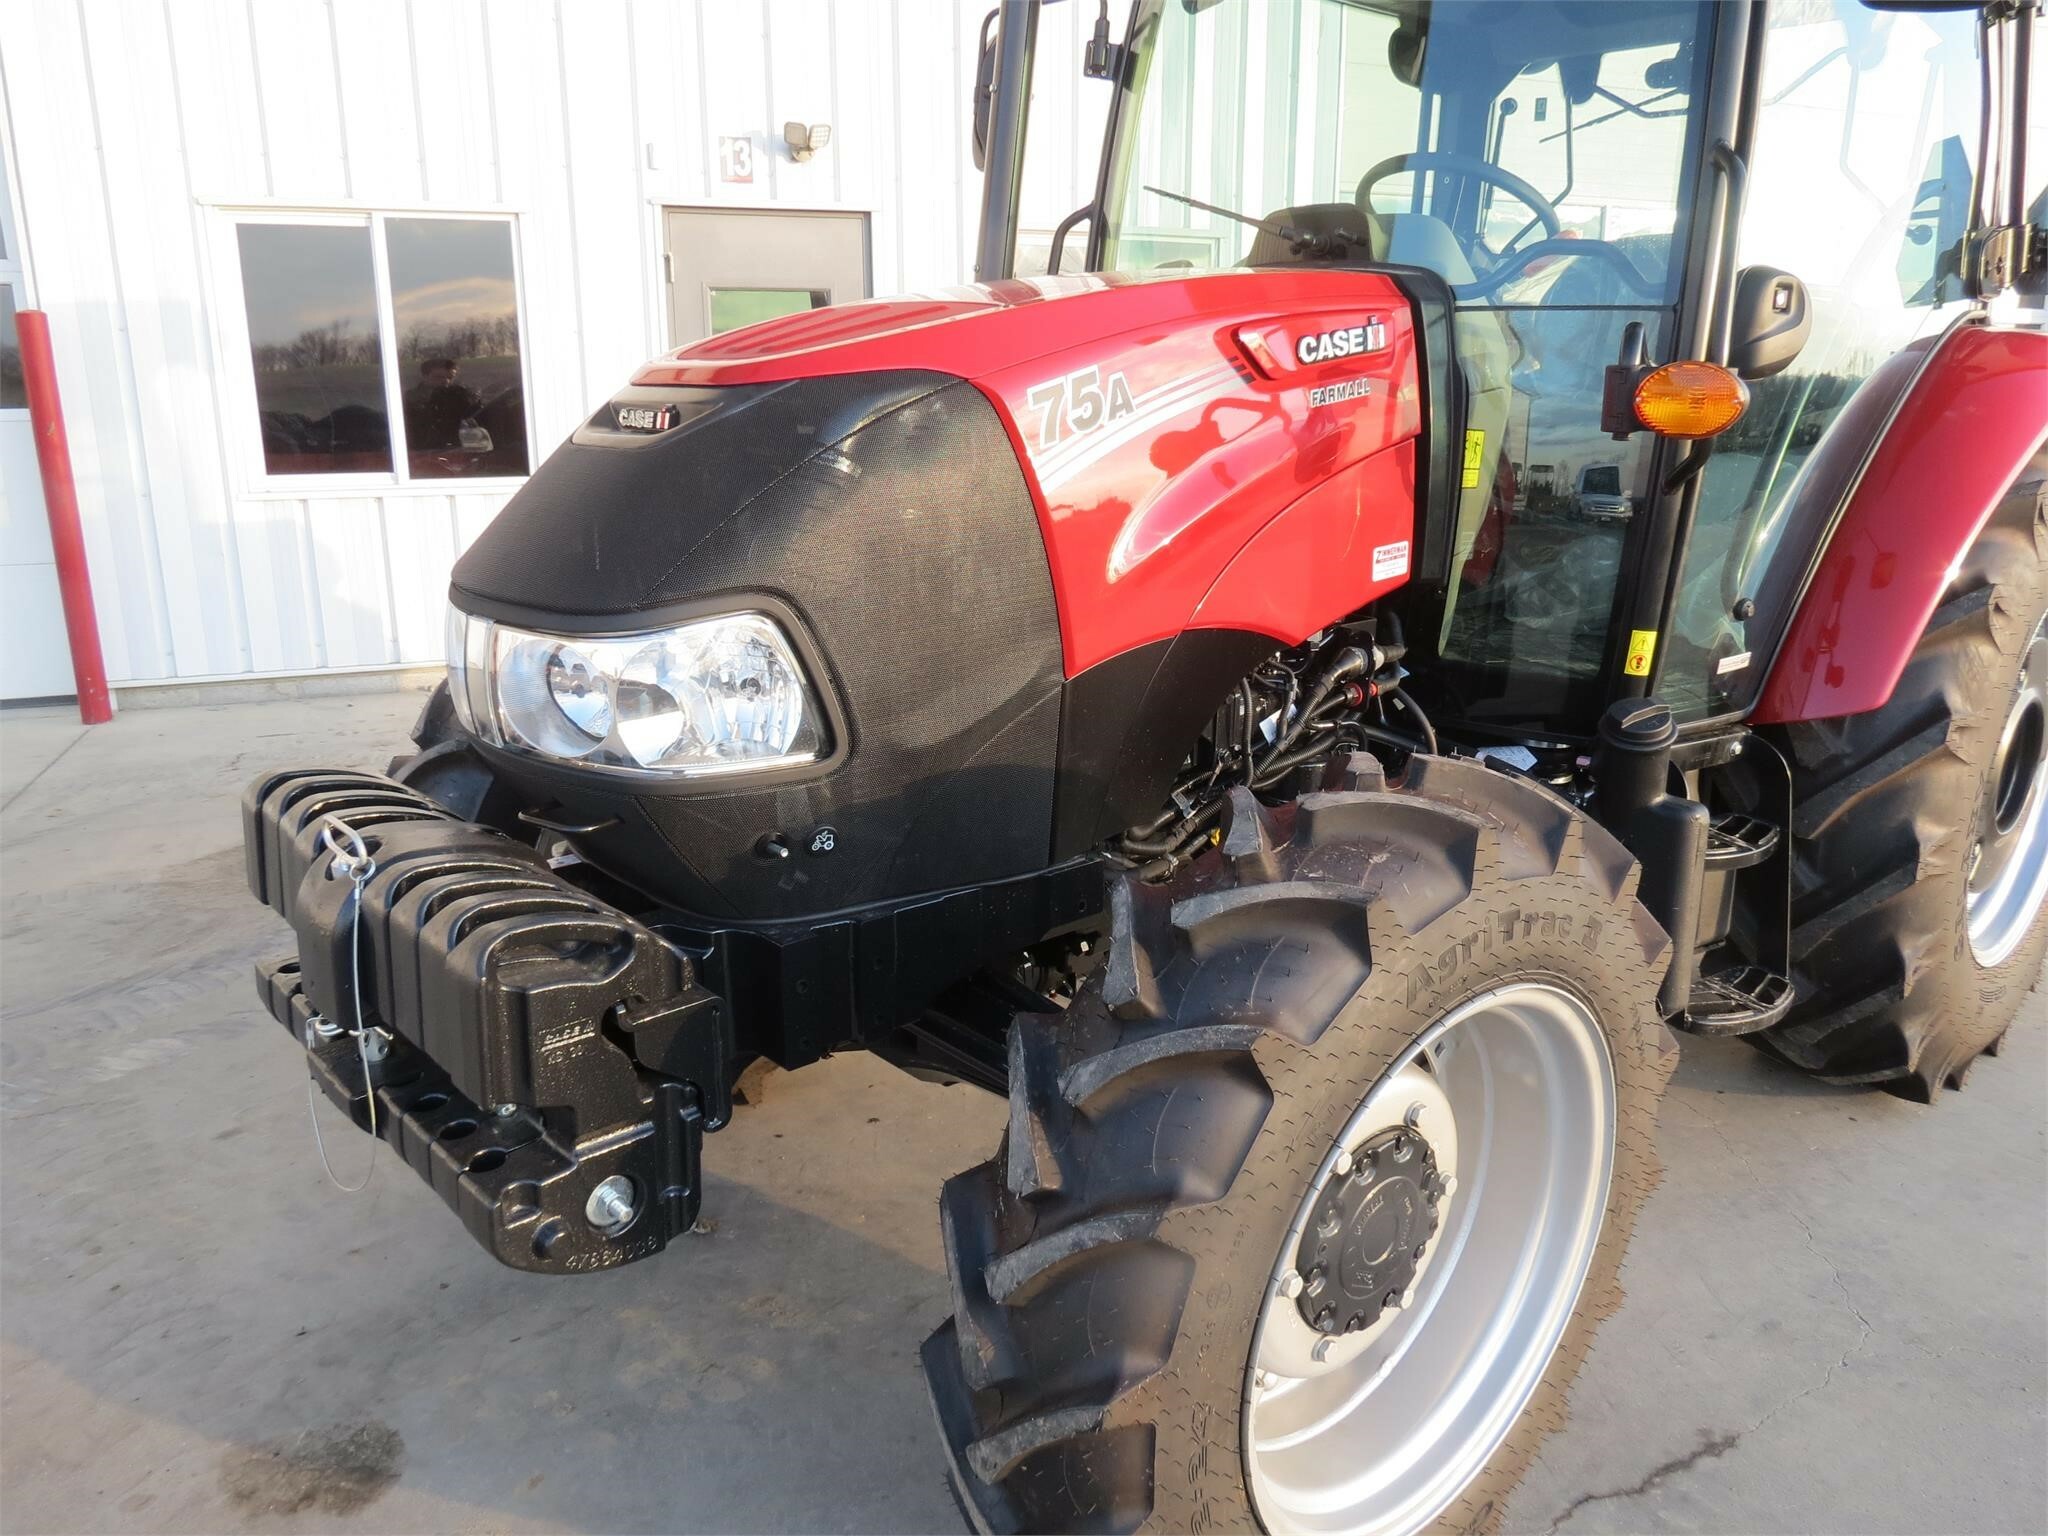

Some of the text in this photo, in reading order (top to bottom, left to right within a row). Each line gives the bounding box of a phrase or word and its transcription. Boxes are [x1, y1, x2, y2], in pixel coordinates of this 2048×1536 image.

[720, 138, 752, 177] 13
[1298, 328, 1364, 363] CASE
[1026, 364, 1136, 449] 75A
[1310, 378, 1371, 408] FARMALL
[619, 408, 654, 428] CASE
